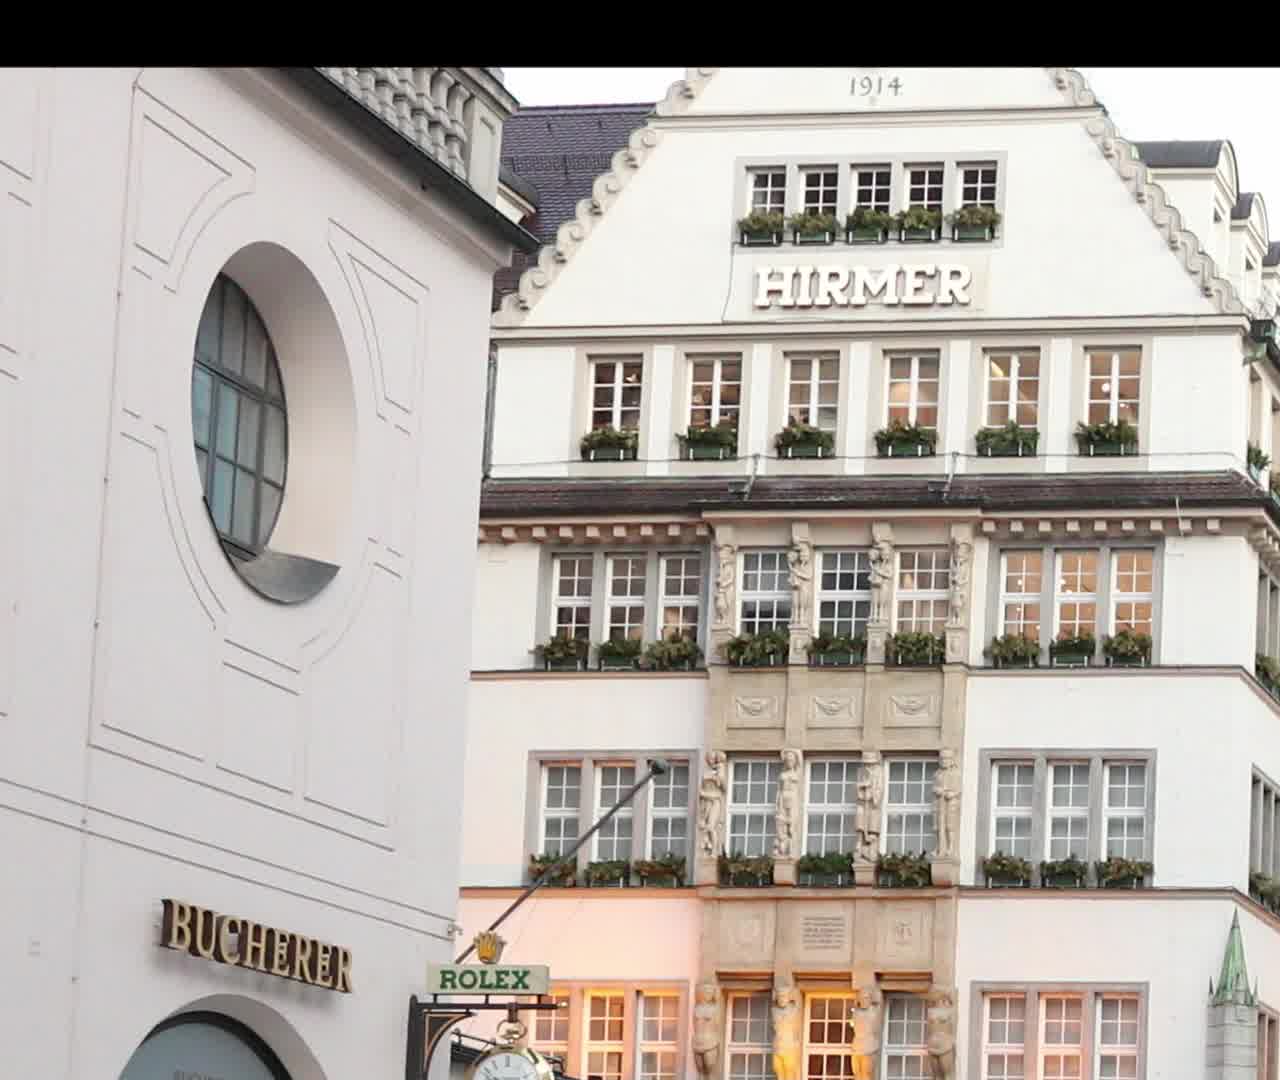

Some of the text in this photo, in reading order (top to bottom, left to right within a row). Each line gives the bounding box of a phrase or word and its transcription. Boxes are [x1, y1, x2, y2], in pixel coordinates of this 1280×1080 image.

[849, 76, 904, 96] 1914
[753, 263, 974, 308] HIRMER
[160, 899, 353, 993] BUCHERER
[440, 969, 530, 990] ROLEX
